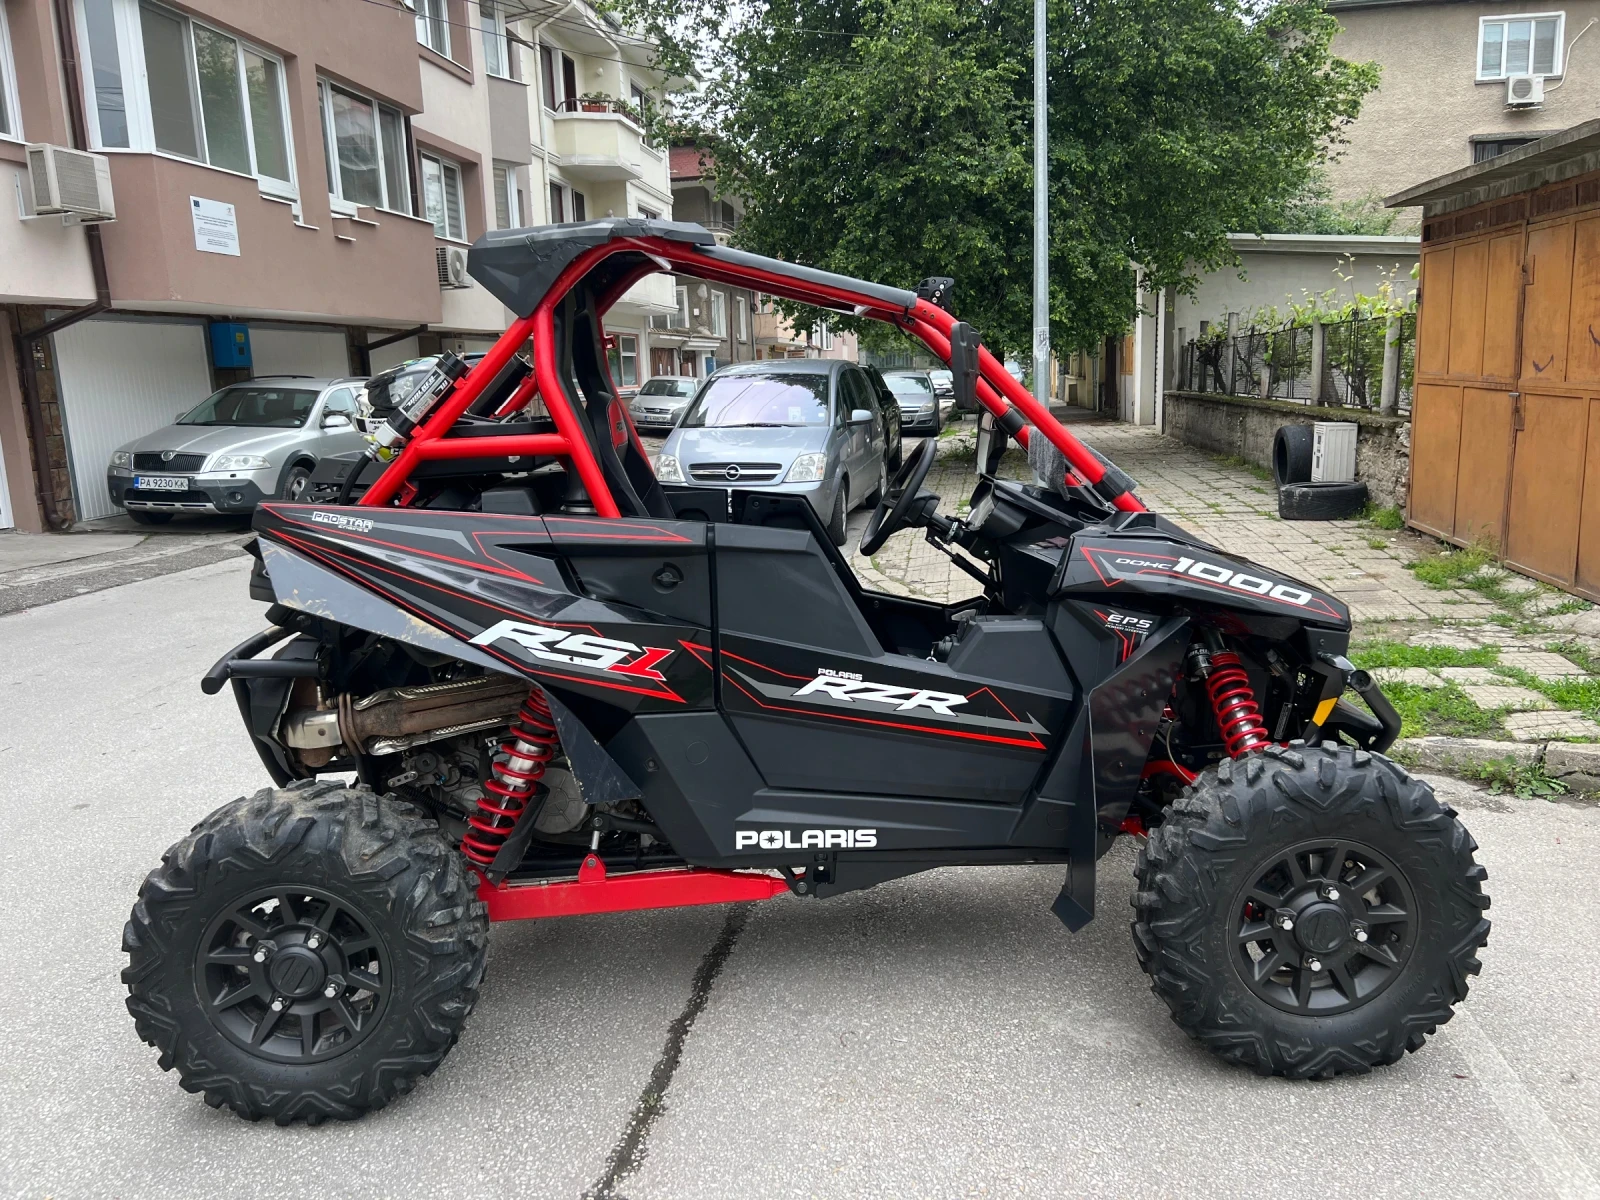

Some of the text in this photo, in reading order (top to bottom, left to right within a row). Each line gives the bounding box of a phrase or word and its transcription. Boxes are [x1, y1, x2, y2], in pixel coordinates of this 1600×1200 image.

[312, 511, 374, 530] PROSTAR
[1115, 556, 1313, 605] DOHC 1000
[1107, 614, 1153, 628] EPS
[468, 619, 675, 681] RS1
[818, 668, 863, 681] POLARIS
[790, 675, 969, 717] RZR
[736, 829, 877, 850] POLARIS
